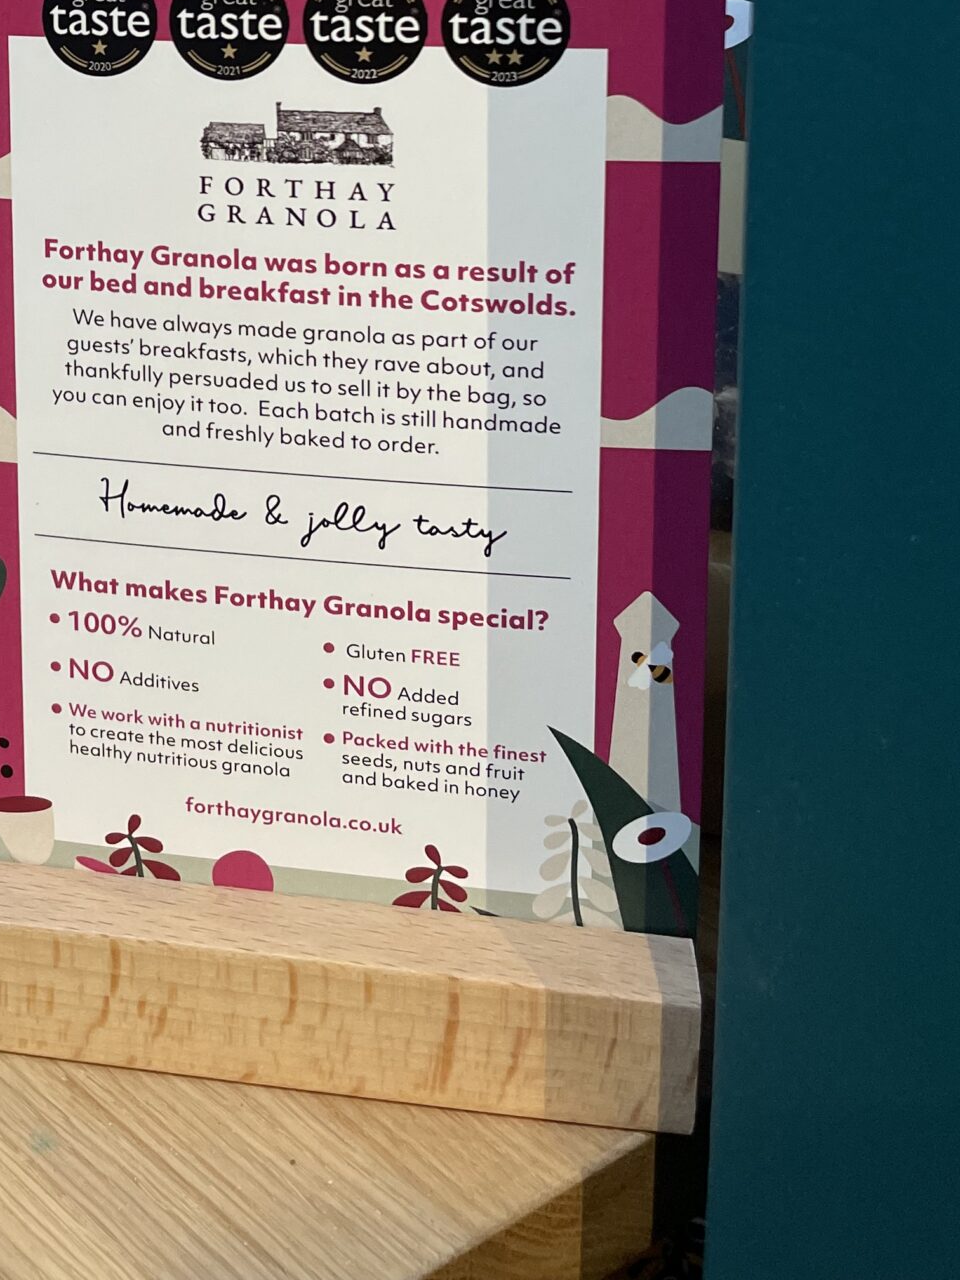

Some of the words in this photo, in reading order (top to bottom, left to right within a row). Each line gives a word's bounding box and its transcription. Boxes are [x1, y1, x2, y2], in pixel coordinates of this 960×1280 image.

[49, 6, 151, 38] taste
[177, 8, 283, 41] taste
[310, 10, 420, 44] taste
[449, 11, 562, 46] taste
[88, 61, 112, 72] 2020
[217, 65, 241, 76] 2021
[351, 69, 377, 80] 2022
[491, 71, 518, 82] 2023
[199, 176, 395, 202] FORTHAY
[198, 204, 397, 230] GRANOLA
[45, 238, 144, 270] Forthay
[151, 245, 256, 270] Granola
[264, 257, 317, 273] was
[325, 253, 387, 277] born
[395, 263, 425, 279] as
[433, 265, 449, 279] a
[458, 261, 538, 283] result
[546, 262, 576, 284] of
[42, 274, 83, 290] our
[90, 270, 136, 293] bed
[144, 276, 191, 297] and
[200, 277, 331, 305] breakfast
[339, 285, 361, 307] in
[369, 287, 413, 309] the
[421, 290, 576, 316] Cotswolds.
[73, 308, 104, 326] We
[111, 310, 157, 330] have
[163, 314, 232, 339] always
[239, 321, 296, 339] made
[303, 326, 385, 345] granola
[392, 333, 415, 345] as
[422, 334, 468, 351] part
[474, 332, 497, 349] of
[502, 338, 538, 351] our
[140, 338, 251, 366] breakfasts,
[258, 347, 316, 367] which
[323, 351, 368, 374] they
[375, 359, 420, 373] rave
[427, 356, 495, 380] about,
[502, 361, 544, 379] and
[65, 359, 163, 387] thankfully
[170, 372, 277, 391] persuaded
[285, 380, 305, 393] us
[311, 380, 332, 394] to
[338, 379, 370, 397] sell
[378, 381, 390, 398] it
[397, 381, 421, 404] by
[427, 383, 461, 402] the
[468, 385, 516, 409] bag,
[523, 394, 546, 406] so
[52, 389, 86, 405] you
[92, 393, 126, 406] can
[133, 393, 185, 415] enjoy
[191, 396, 203, 412] it
[208, 399, 247, 415] too.
[259, 400, 308, 419] Each
[316, 403, 374, 424] batch
[381, 408, 395, 425] is
[401, 410, 435, 427] still
[443, 411, 561, 434] handmade
[162, 421, 200, 438] and
[206, 422, 274, 448] freshly
[280, 427, 344, 448] baked
[351, 435, 371, 450] to
[378, 436, 439, 454] order.
[99, 477, 247, 521] Homemade
[265, 494, 288, 525] &
[300, 502, 401, 550] jolly
[413, 514, 507, 557] tasty
[50, 569, 119, 595] What
[126, 580, 207, 603] makes
[215, 586, 316, 618] Forthay
[324, 595, 430, 622] Granola
[438, 608, 549, 631] special?
[68, 611, 142, 637] 100%
[149, 625, 215, 645] Natural
[347, 644, 405, 662] Gluten
[412, 649, 460, 667] FREE
[70, 658, 114, 682] NO
[120, 671, 199, 692] Additives
[344, 675, 391, 698] NO
[398, 687, 458, 705] Added
[69, 702, 96, 718] We
[101, 709, 143, 724] work
[148, 713, 185, 728] with
[190, 720, 200, 730] a
[206, 721, 303, 740] nutritionist
[343, 702, 406, 720] refined
[411, 712, 472, 727] sugars
[69, 724, 85, 736] to
[91, 727, 134, 743] create
[149, 730, 175, 746] the
[181, 738, 223, 751] most
[228, 739, 303, 760] delicious
[70, 739, 132, 764] healthy
[137, 752, 217, 769] nutritious
[222, 761, 290, 777] granola
[343, 731, 408, 750] Packed
[414, 739, 453, 755] with
[458, 742, 488, 758] the
[493, 744, 547, 763] finest
[342, 753, 397, 772] seeds,
[404, 761, 440, 773] nuts
[446, 762, 480, 776] and
[486, 763, 525, 780] fruit
[342, 771, 376, 786] and
[382, 772, 438, 792] baked
[444, 779, 458, 794] in
[465, 780, 520, 803] honey
[185, 797, 403, 835] forthaygranola.co.uk
